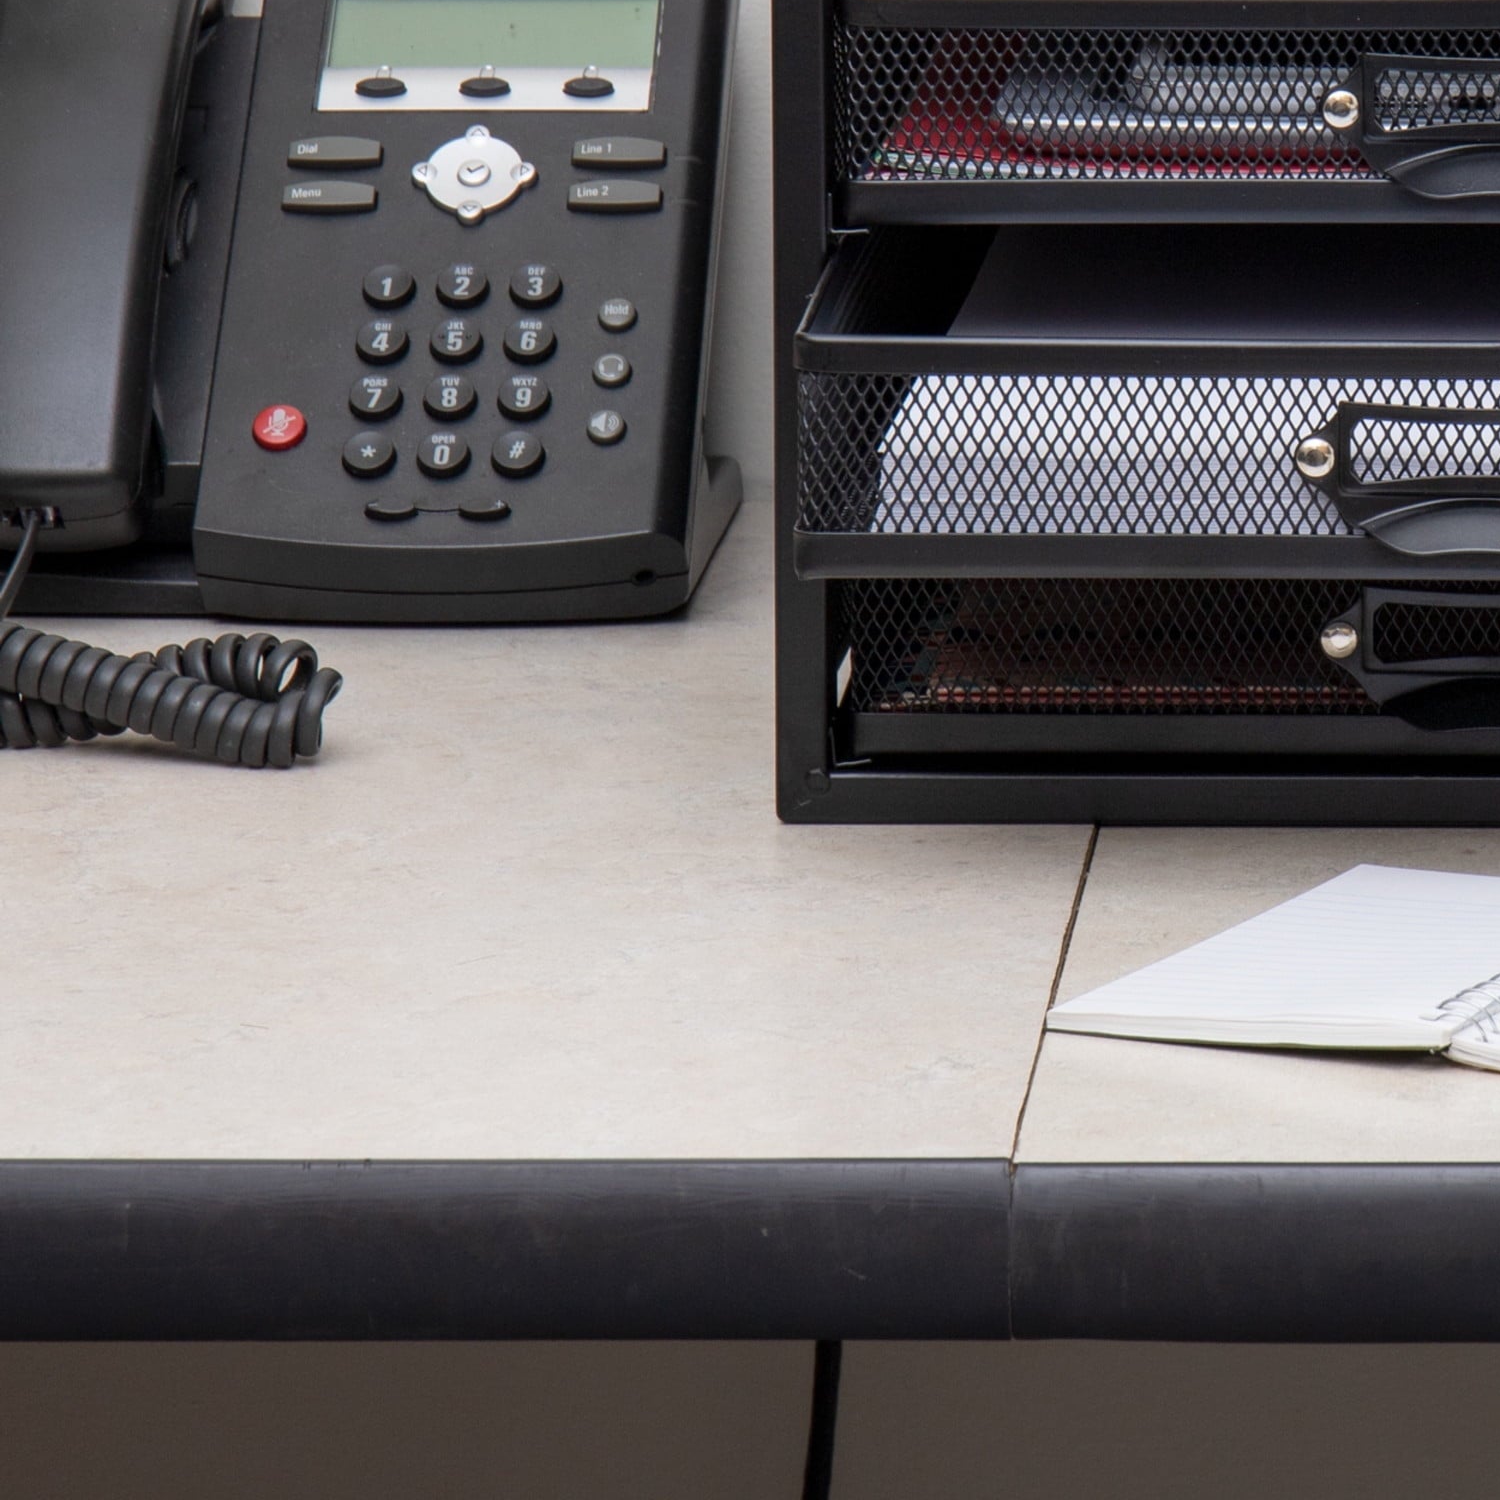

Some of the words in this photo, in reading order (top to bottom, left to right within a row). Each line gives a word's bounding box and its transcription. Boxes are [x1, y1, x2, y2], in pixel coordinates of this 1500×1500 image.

[296, 143, 319, 155] Dial
[580, 143, 603, 154] Line
[290, 188, 322, 199] Menu
[576, 186, 599, 198] Line
[600, 185, 609, 196] 2
[454, 266, 474, 276] ABC
[527, 266, 546, 276] DEF
[380, 277, 393, 297] 1
[453, 276, 471, 296] 2
[527, 277, 544, 297] 3
[604, 304, 629, 316] Hold
[374, 322, 392, 331] GHI
[446, 321, 465, 331] JKL
[371, 332, 389, 352] 4
[446, 331, 464, 351] 5
[520, 331, 537, 351] 6
[440, 377, 460, 386] TUV
[511, 377, 538, 387] WXYZ
[366, 388, 382, 408] 7
[441, 387, 458, 408] 8
[514, 387, 532, 408] 9
[431, 434, 456, 444] OPER
[432, 445, 450, 465] 0
